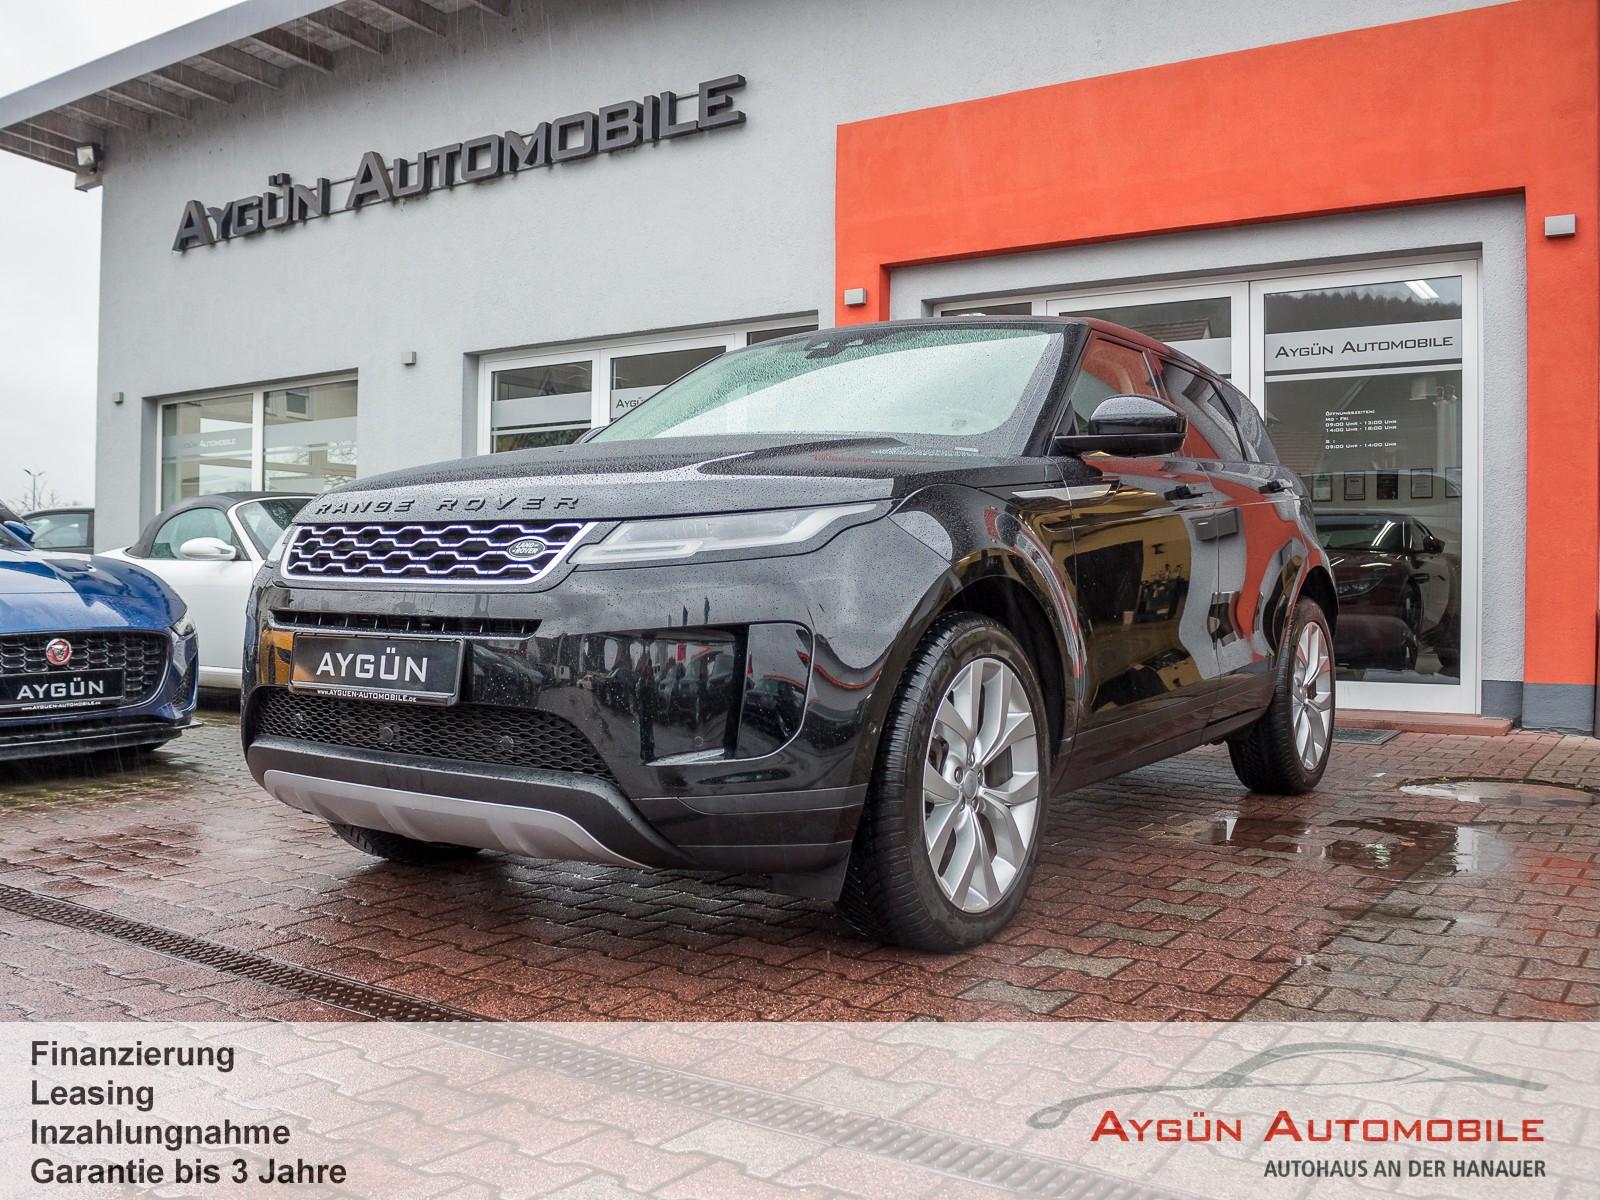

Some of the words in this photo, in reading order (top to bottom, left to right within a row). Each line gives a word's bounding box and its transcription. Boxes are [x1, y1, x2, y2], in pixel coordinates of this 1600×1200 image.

[172, 173, 330, 251] AYGÜN
[345, 74, 747, 211] AUTOMOBILE
[1275, 343, 1333, 358] AYGÜN
[1341, 336, 1454, 353] AUTOMOBILE
[315, 498, 415, 514] RANGE
[436, 496, 579, 512] ROVER
[316, 647, 428, 683] AYGÜN
[16, 677, 104, 700] AYGÜN
